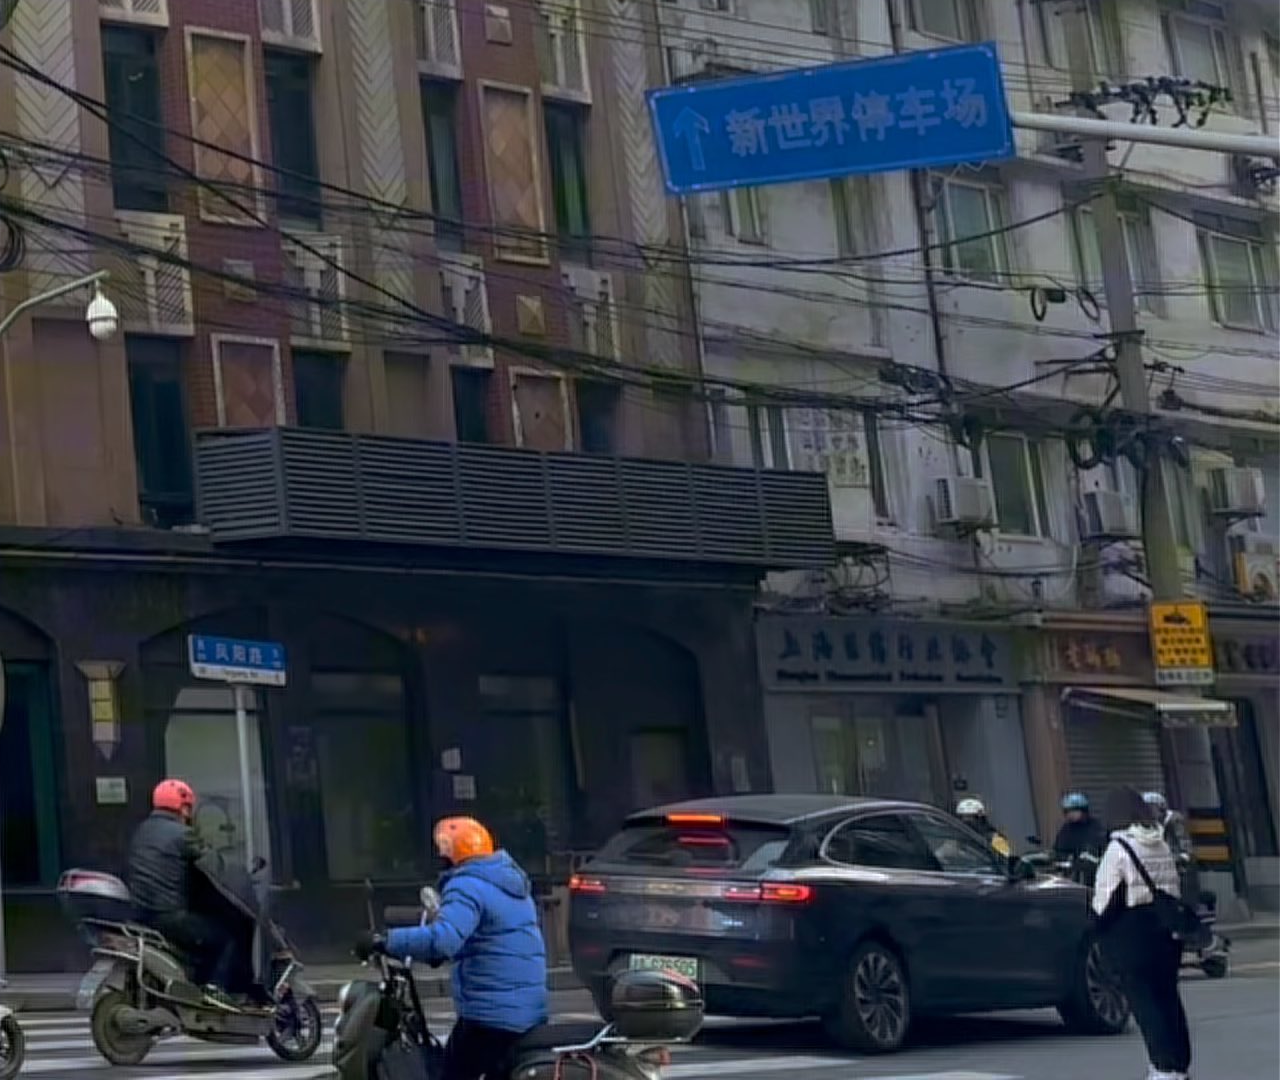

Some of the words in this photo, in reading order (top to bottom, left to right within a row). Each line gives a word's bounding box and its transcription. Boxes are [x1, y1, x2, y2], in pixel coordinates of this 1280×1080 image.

[726, 78, 987, 158] 新世界停车场
